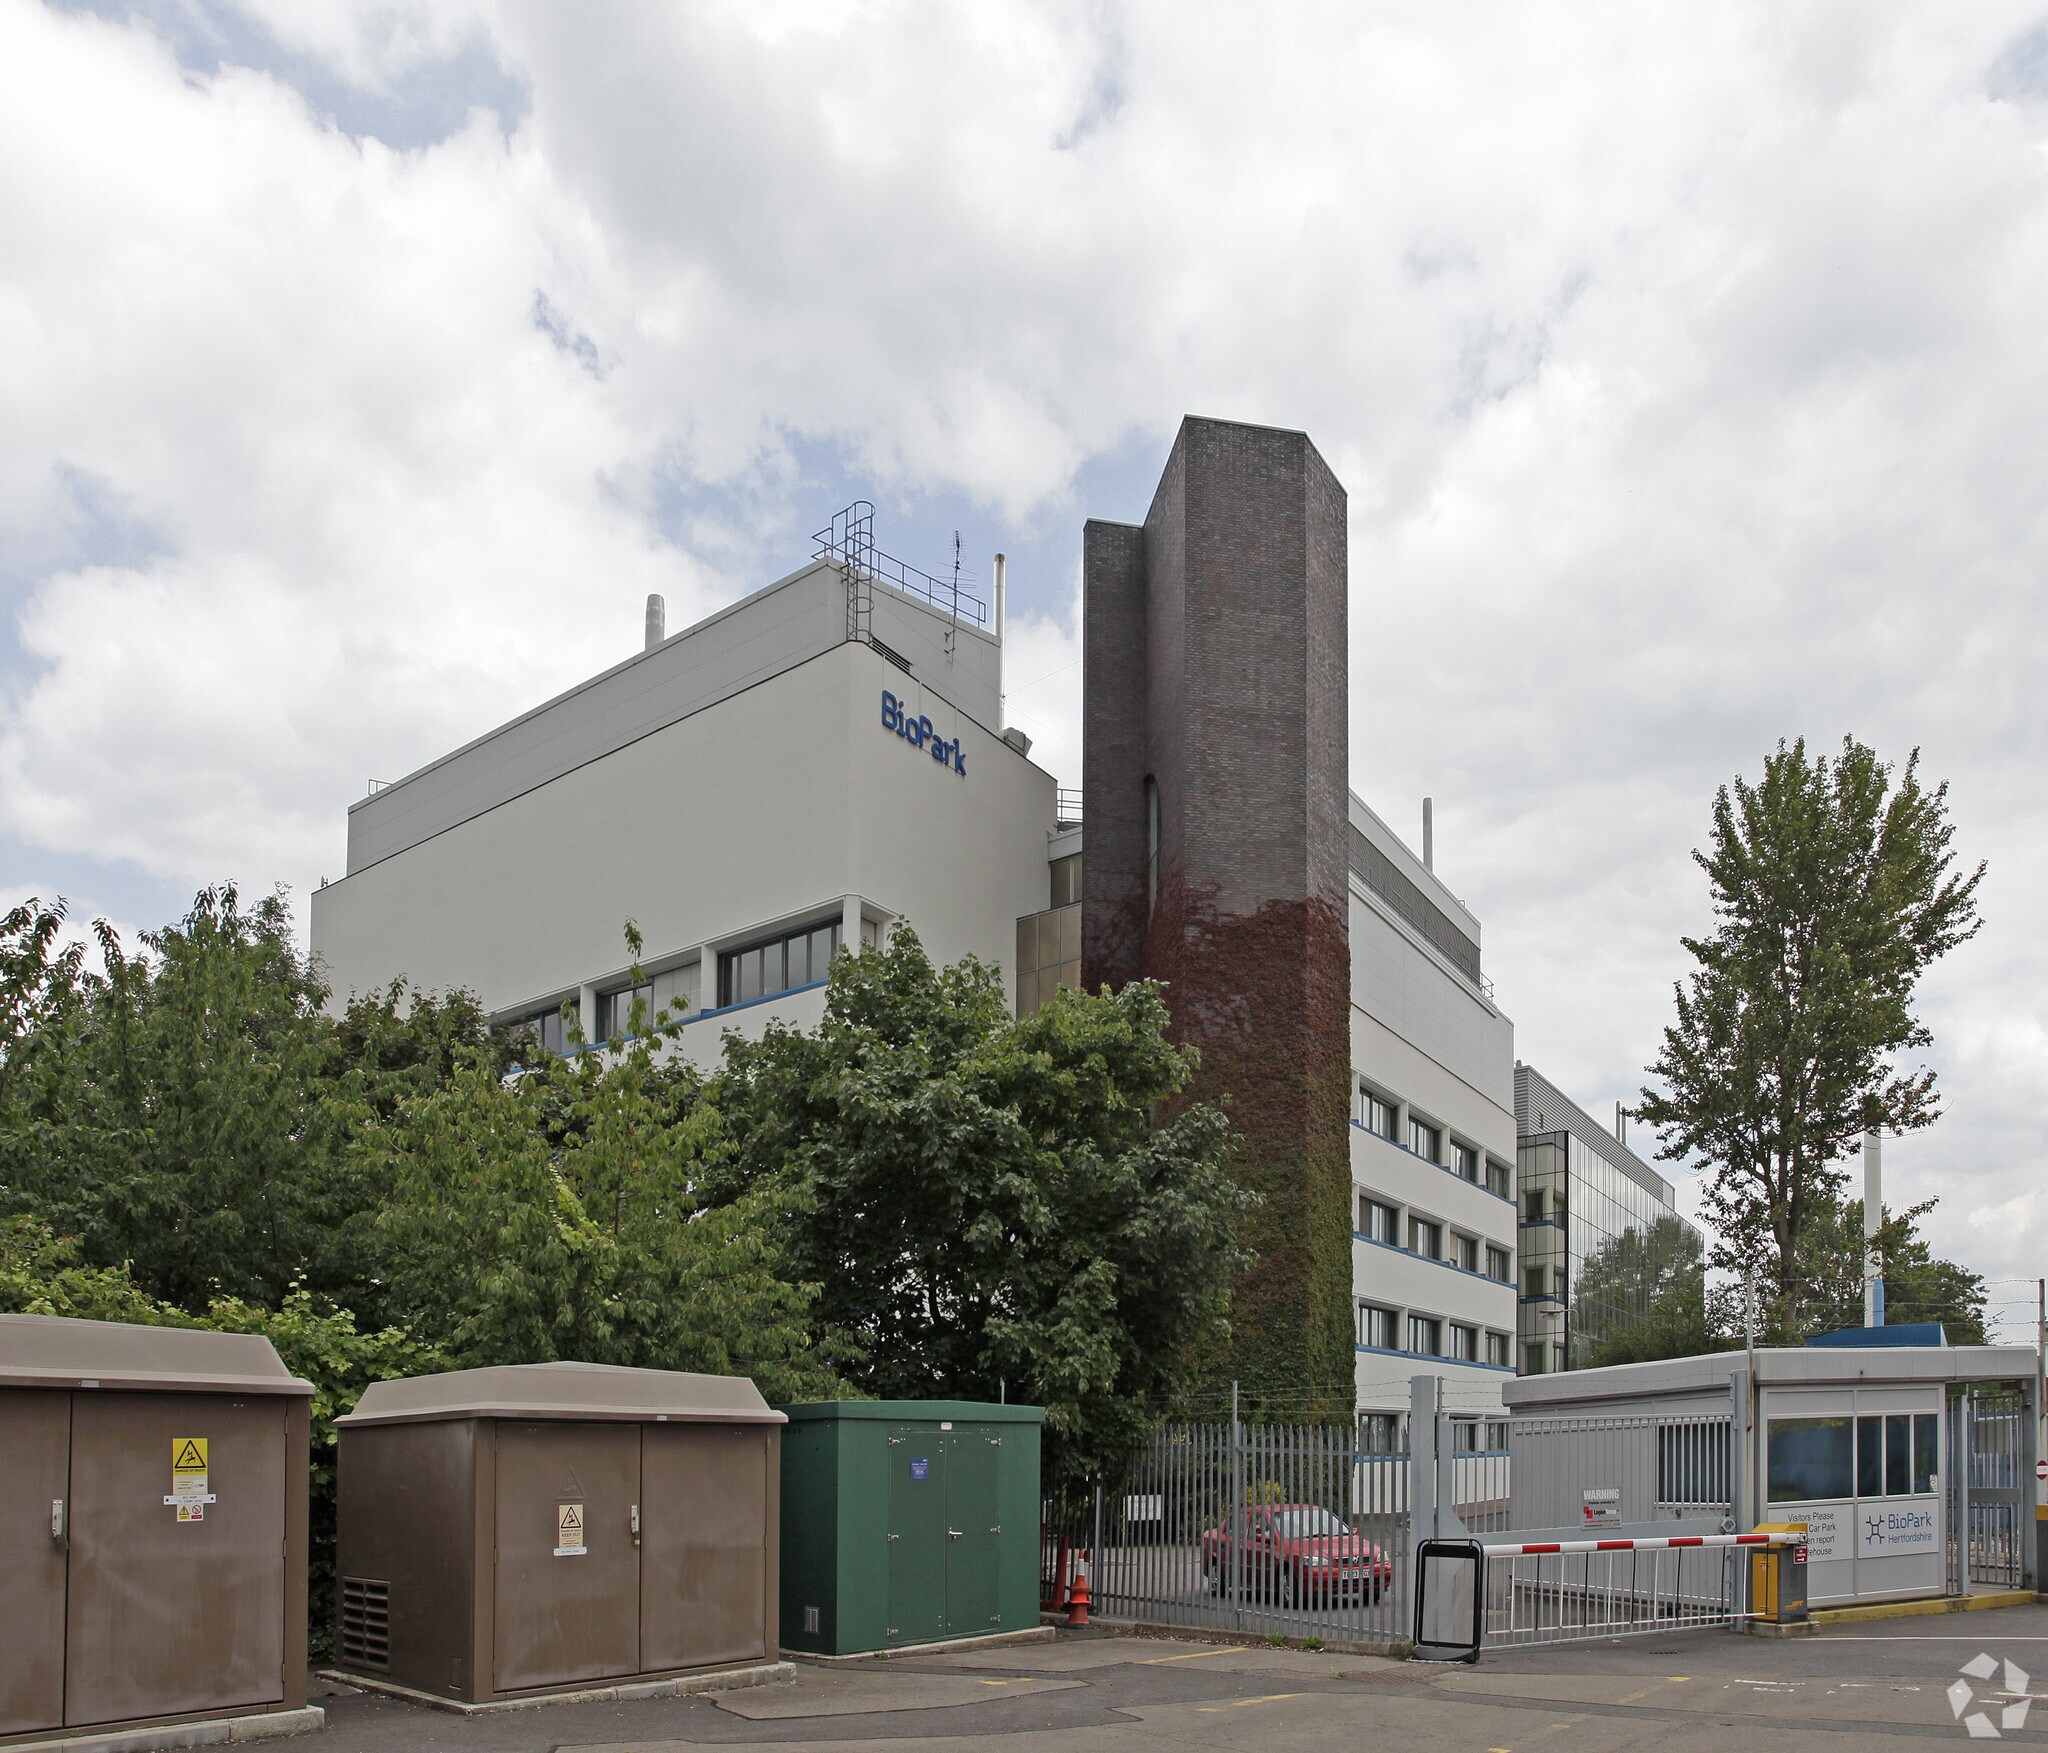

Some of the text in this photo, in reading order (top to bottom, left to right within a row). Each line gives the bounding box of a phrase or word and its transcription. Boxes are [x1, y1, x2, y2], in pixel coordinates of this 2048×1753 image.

[882, 690, 966, 777] BioPark
[1583, 1489, 1620, 1500] WARNING
[1788, 1512, 1834, 1522] Visitors Please
[1888, 1512, 1932, 1529] BioPark
[1808, 1522, 1836, 1533] Car Park
[1816, 1535, 1835, 1545] report
[1888, 1532, 1932, 1544] Hertfordshire
